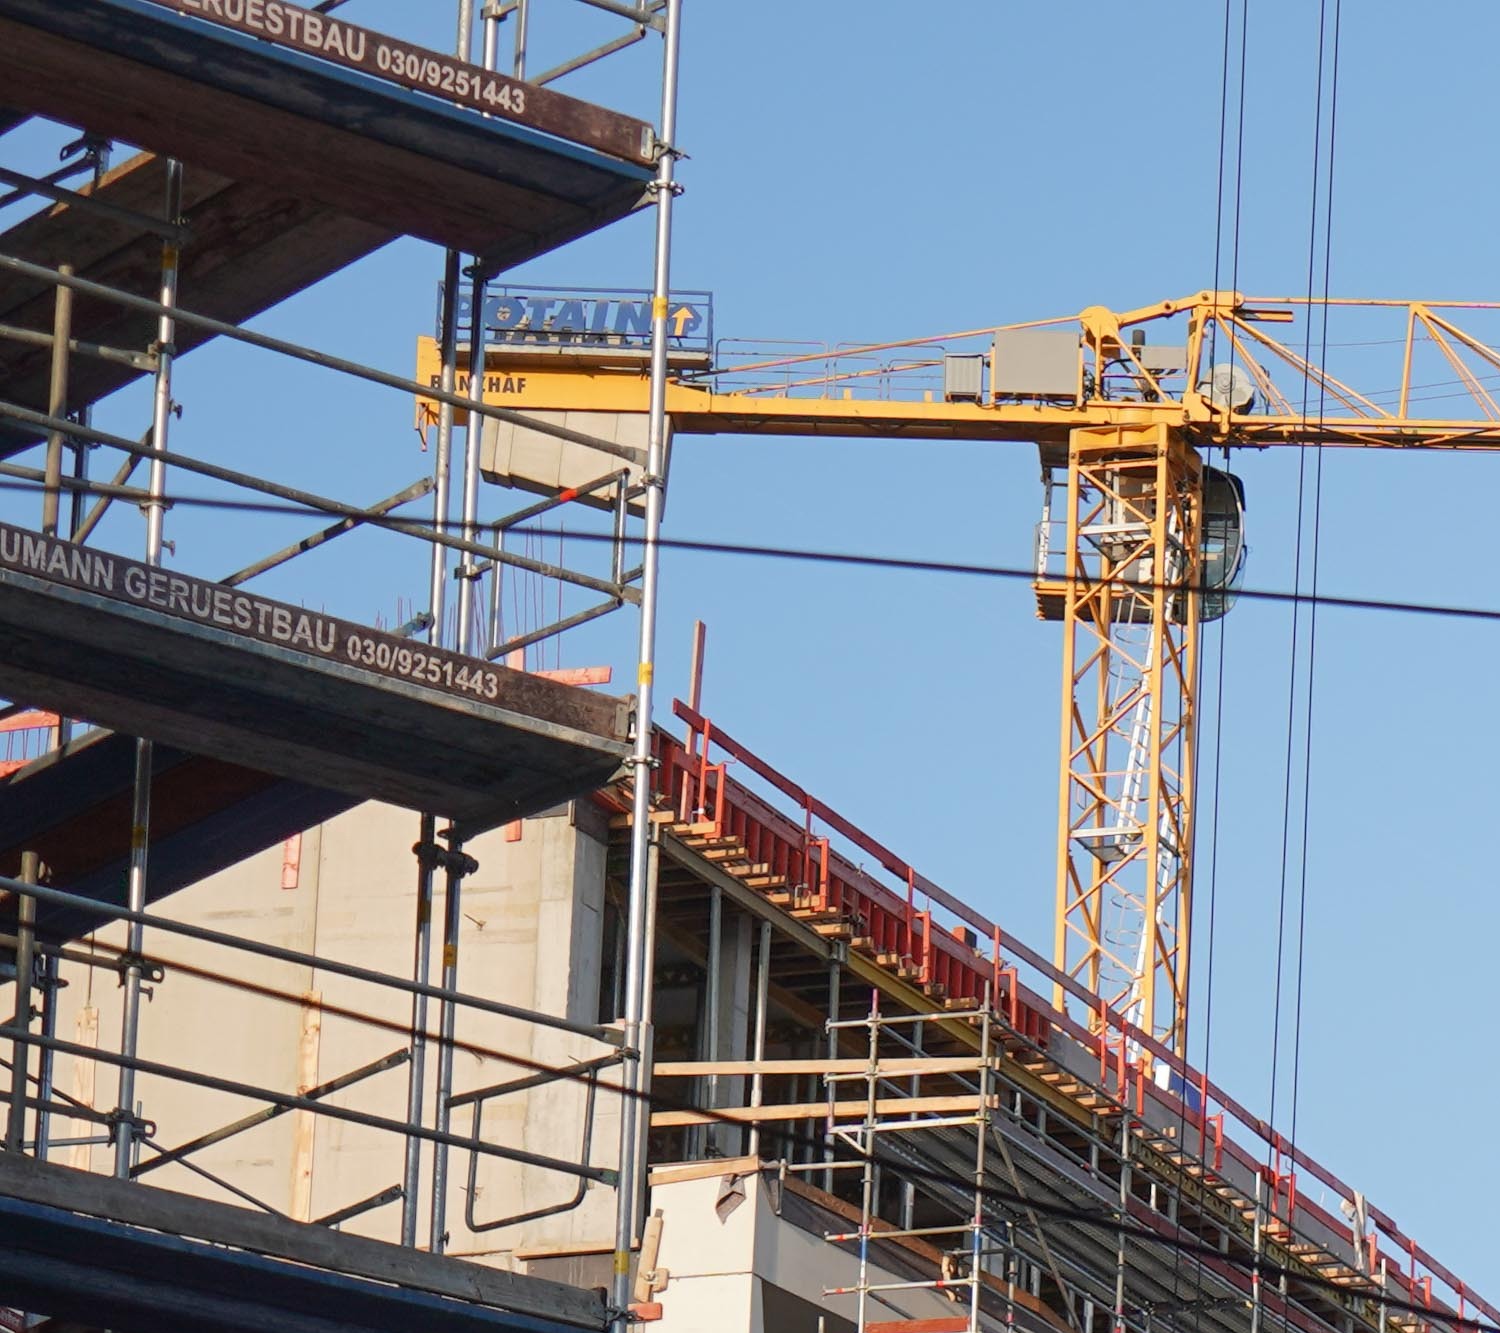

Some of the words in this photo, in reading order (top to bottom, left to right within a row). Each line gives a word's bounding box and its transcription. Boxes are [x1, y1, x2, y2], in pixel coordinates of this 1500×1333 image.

[177, 0, 368, 61] RUESTBAU
[376, 44, 527, 114] 030/9251443
[430, 374, 528, 394] BNHAF
[123, 566, 337, 653] GERUESTBAU
[346, 634, 499, 699] 030/9251443
